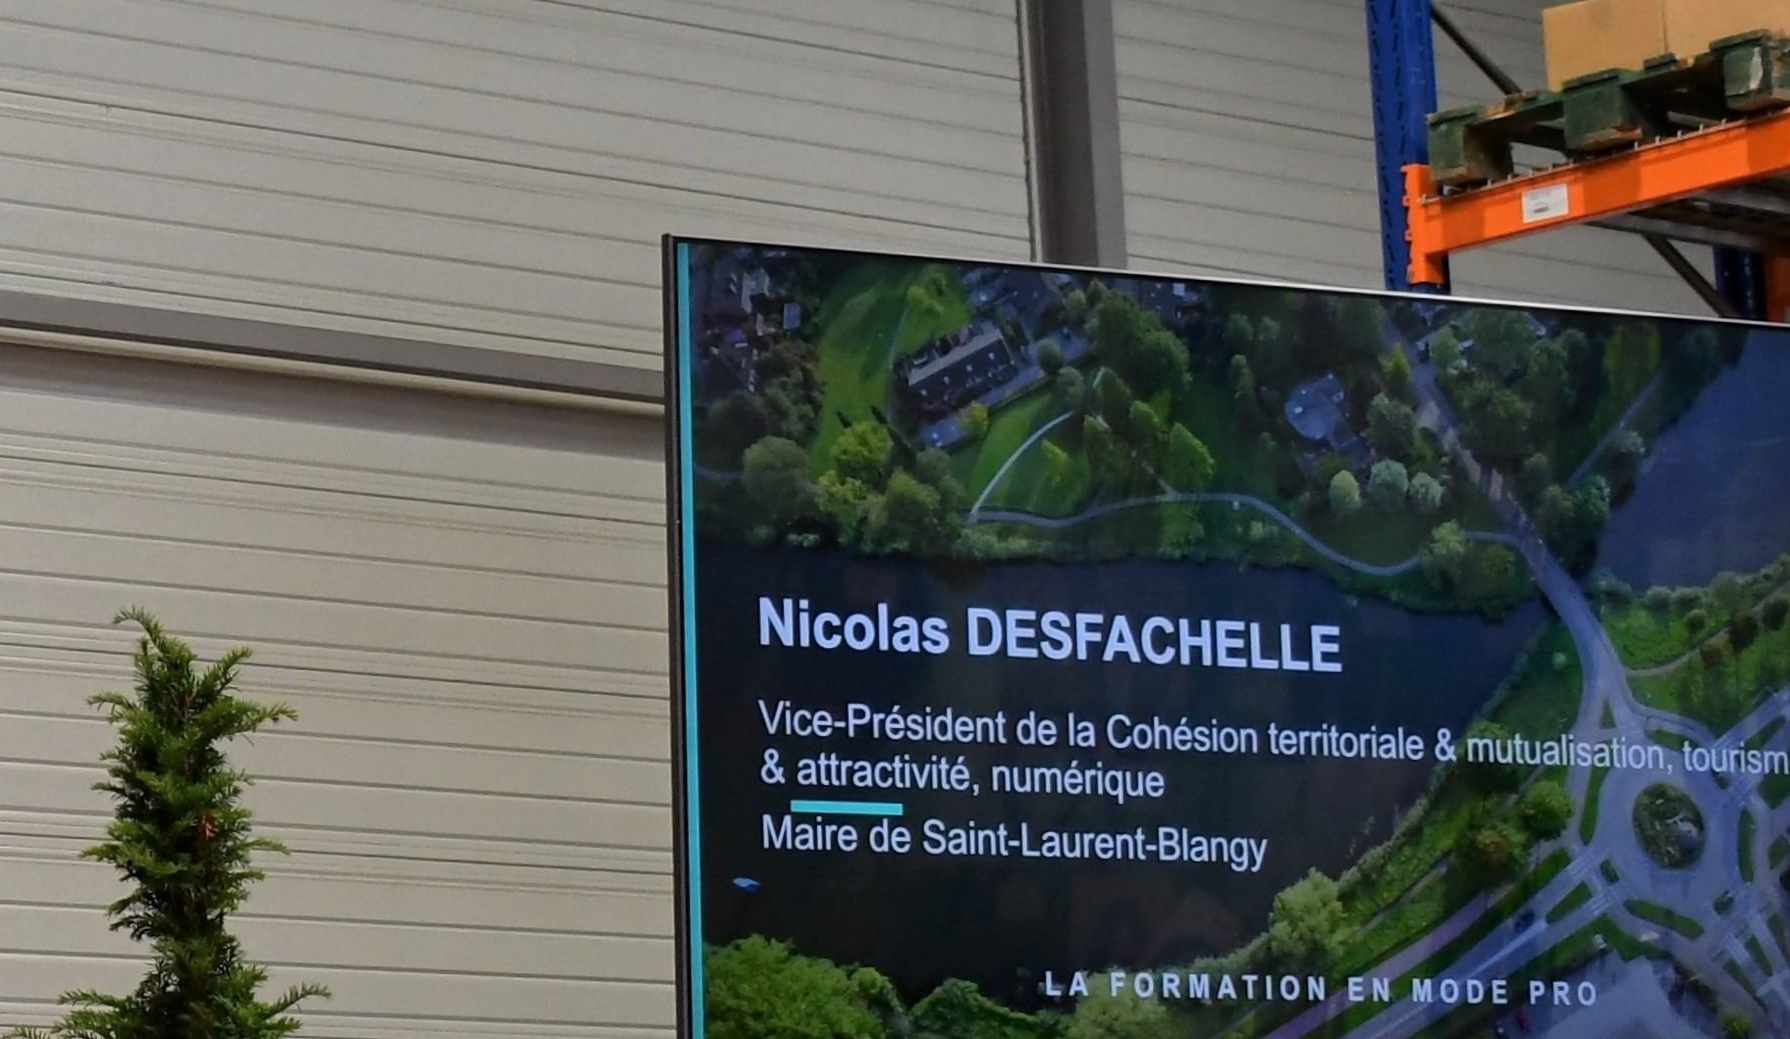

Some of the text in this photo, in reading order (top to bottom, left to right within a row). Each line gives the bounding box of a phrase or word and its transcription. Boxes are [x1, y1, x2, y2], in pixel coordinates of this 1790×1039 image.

[758, 597, 1342, 673] Nicolas DESFACHELLE
[758, 700, 1790, 775] Vice-Président de la Cohésion territoriale & mutualisation, tourism
[760, 749, 1165, 804] & attractivité, numérique
[762, 815, 1268, 872] Maire de Saint-Laurent-Blangy
[1045, 971, 1597, 1006] LA FORMATION EN MODE PRO
